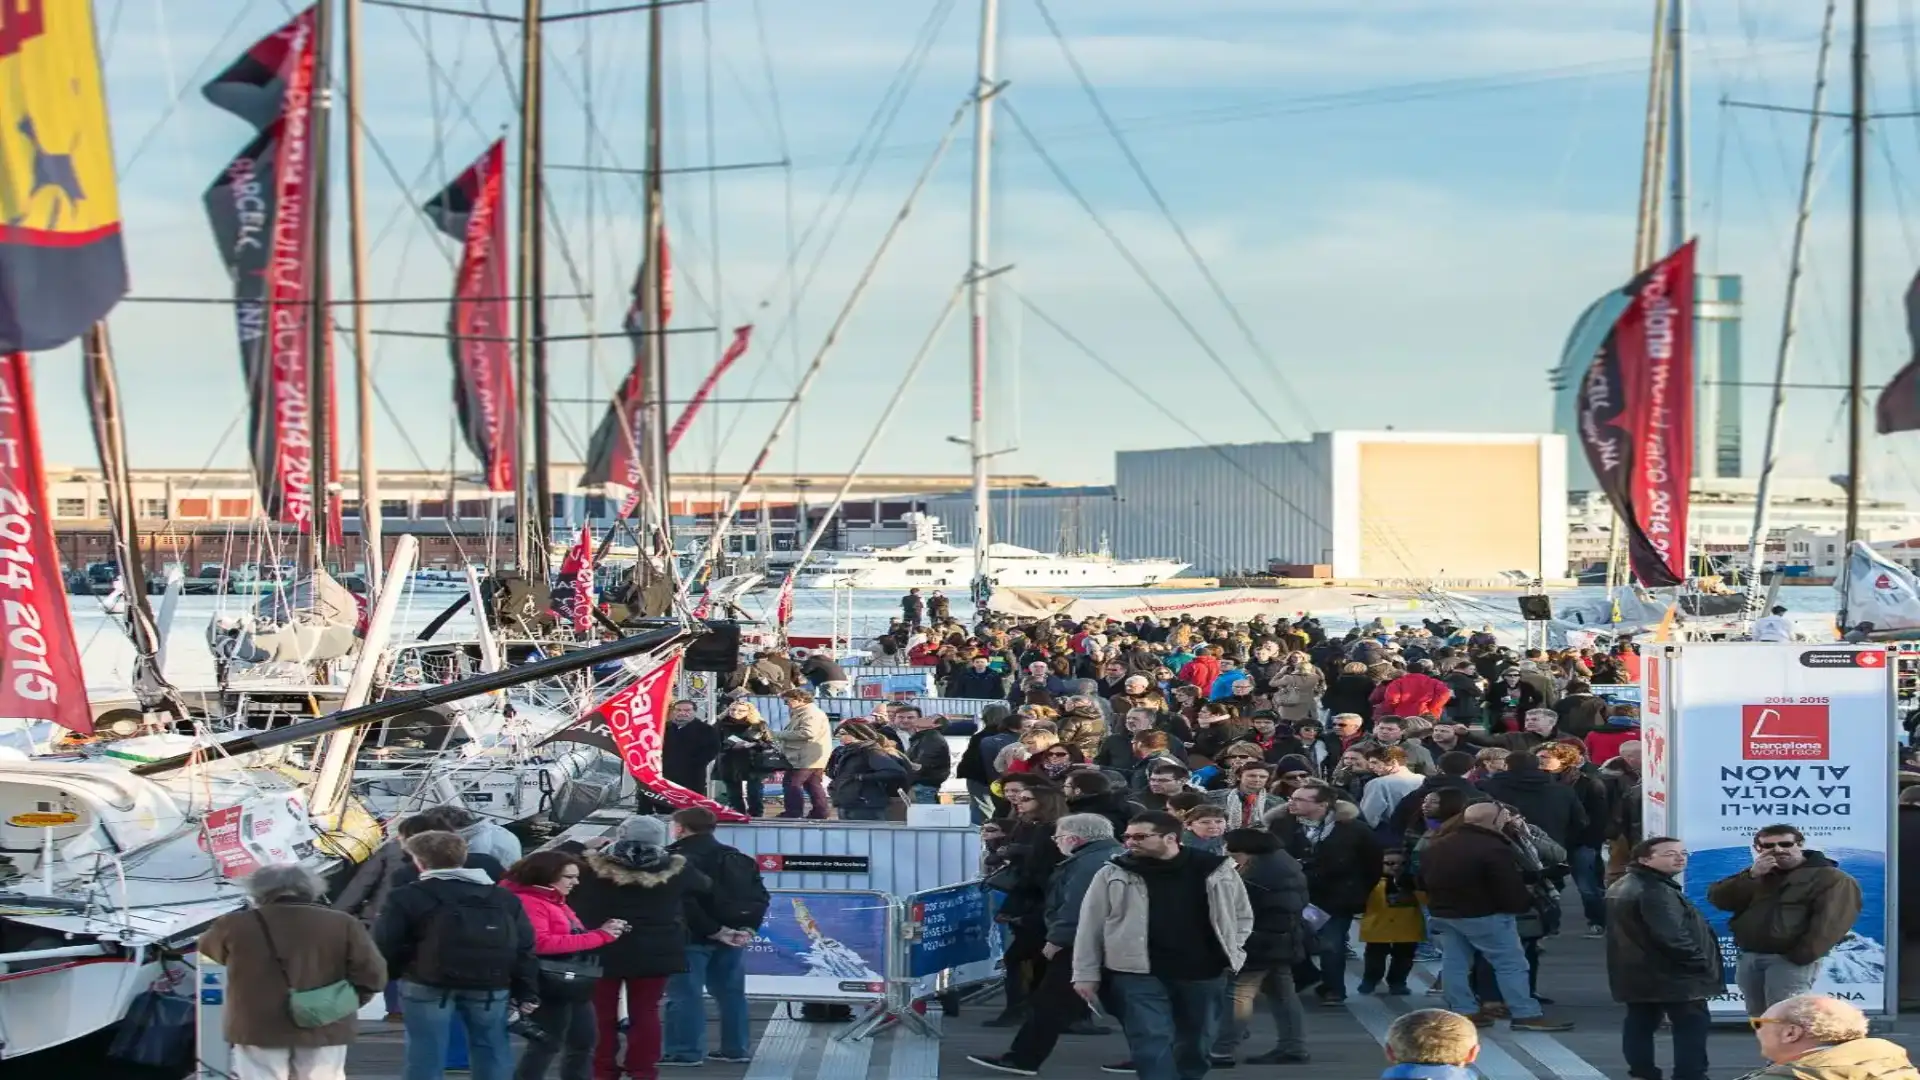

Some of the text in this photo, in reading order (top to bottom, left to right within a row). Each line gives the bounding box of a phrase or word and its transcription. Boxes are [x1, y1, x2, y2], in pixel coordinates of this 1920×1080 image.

[0, 485, 35, 591] 2014
[5, 598, 58, 705] 2015
[1750, 741, 1822, 750] barcelona
[1809, 765, 1850, 781] AL
[1722, 785, 1851, 798] LA VOLTA
[1721, 803, 1851, 816] DONEM-LI
[747, 945, 774, 953] 2015
